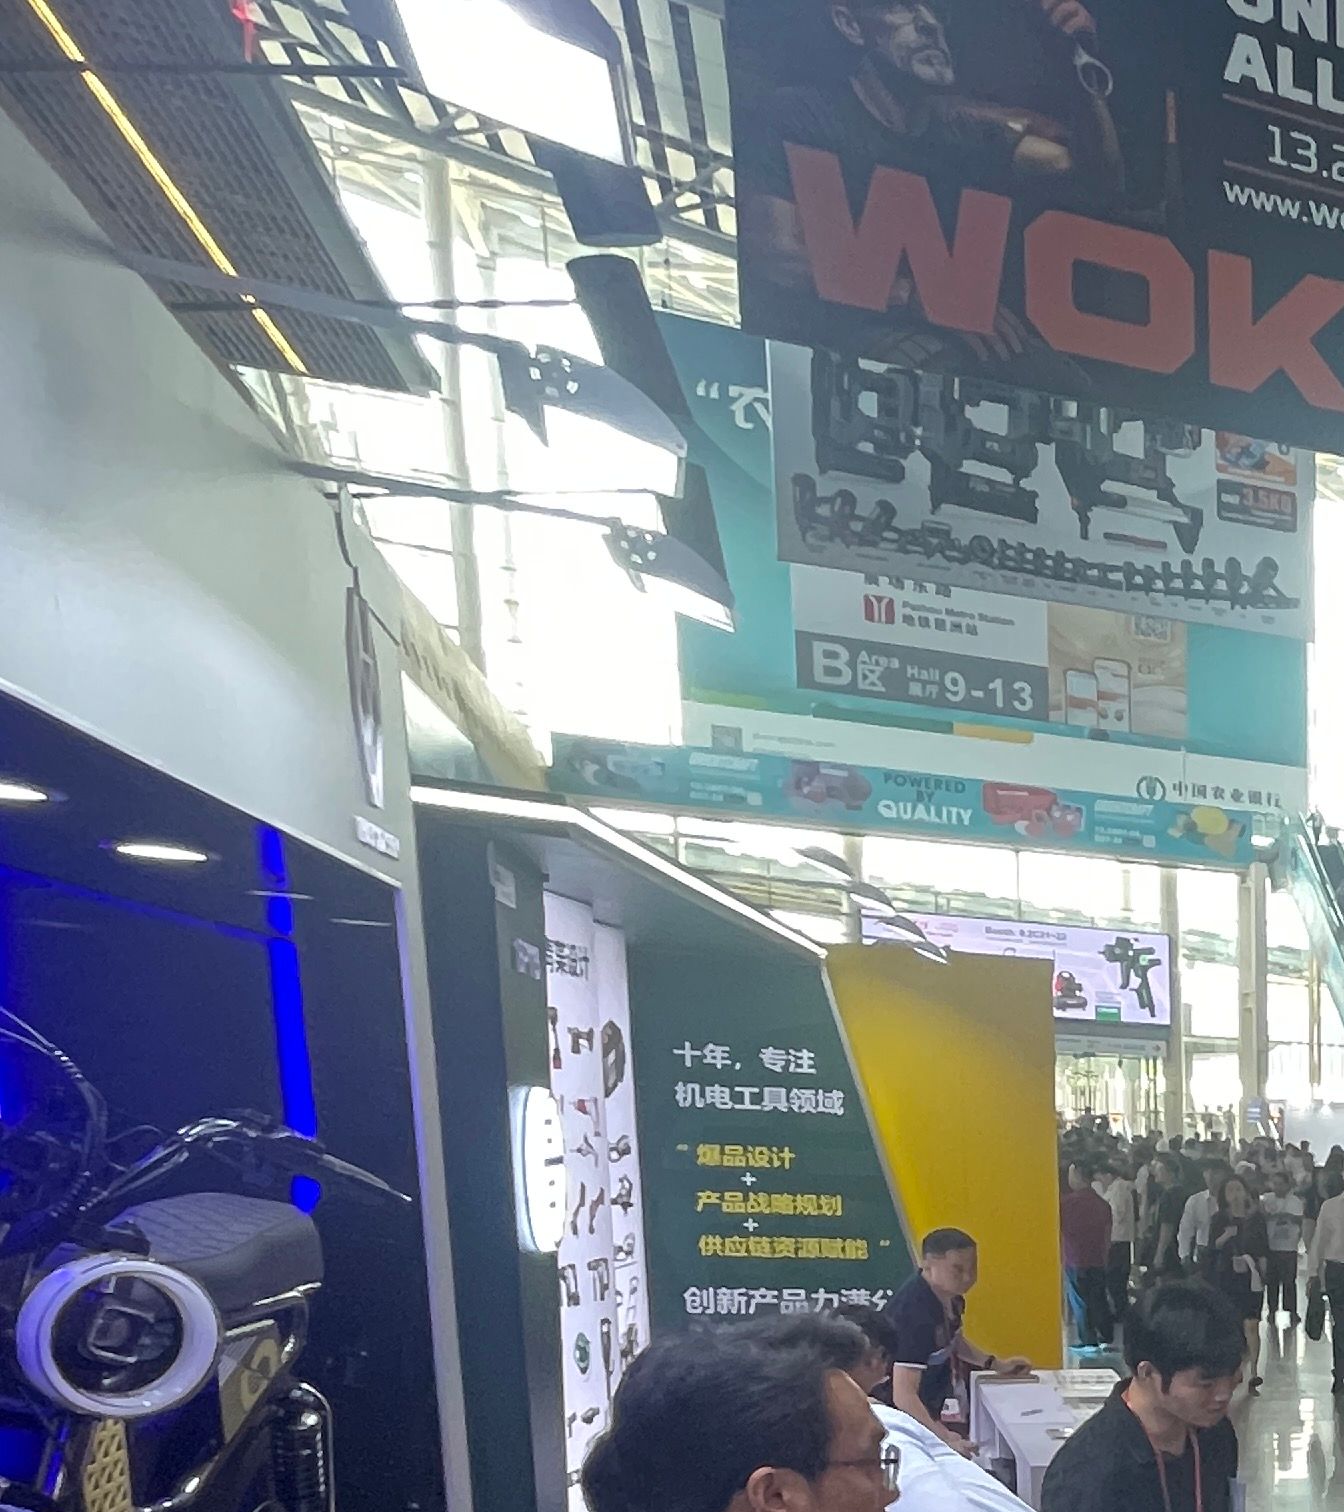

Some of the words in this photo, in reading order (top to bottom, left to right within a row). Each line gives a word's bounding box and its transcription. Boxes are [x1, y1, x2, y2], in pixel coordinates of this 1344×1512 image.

[811, 641, 853, 688] B
[857, 650, 900, 671] Area
[856, 666, 887, 693] 区
[906, 664, 941, 684] Hall
[943, 672, 1035, 712] 9-13
[883, 771, 967, 796] POWERED
[915, 788, 935, 803] BY
[876, 799, 973, 828] QUALITY
[674, 1081, 846, 1116] 机电工具领域
[695, 1190, 843, 1218] 产品战略规划
[697, 1234, 869, 1260] 供应链资源赋能
